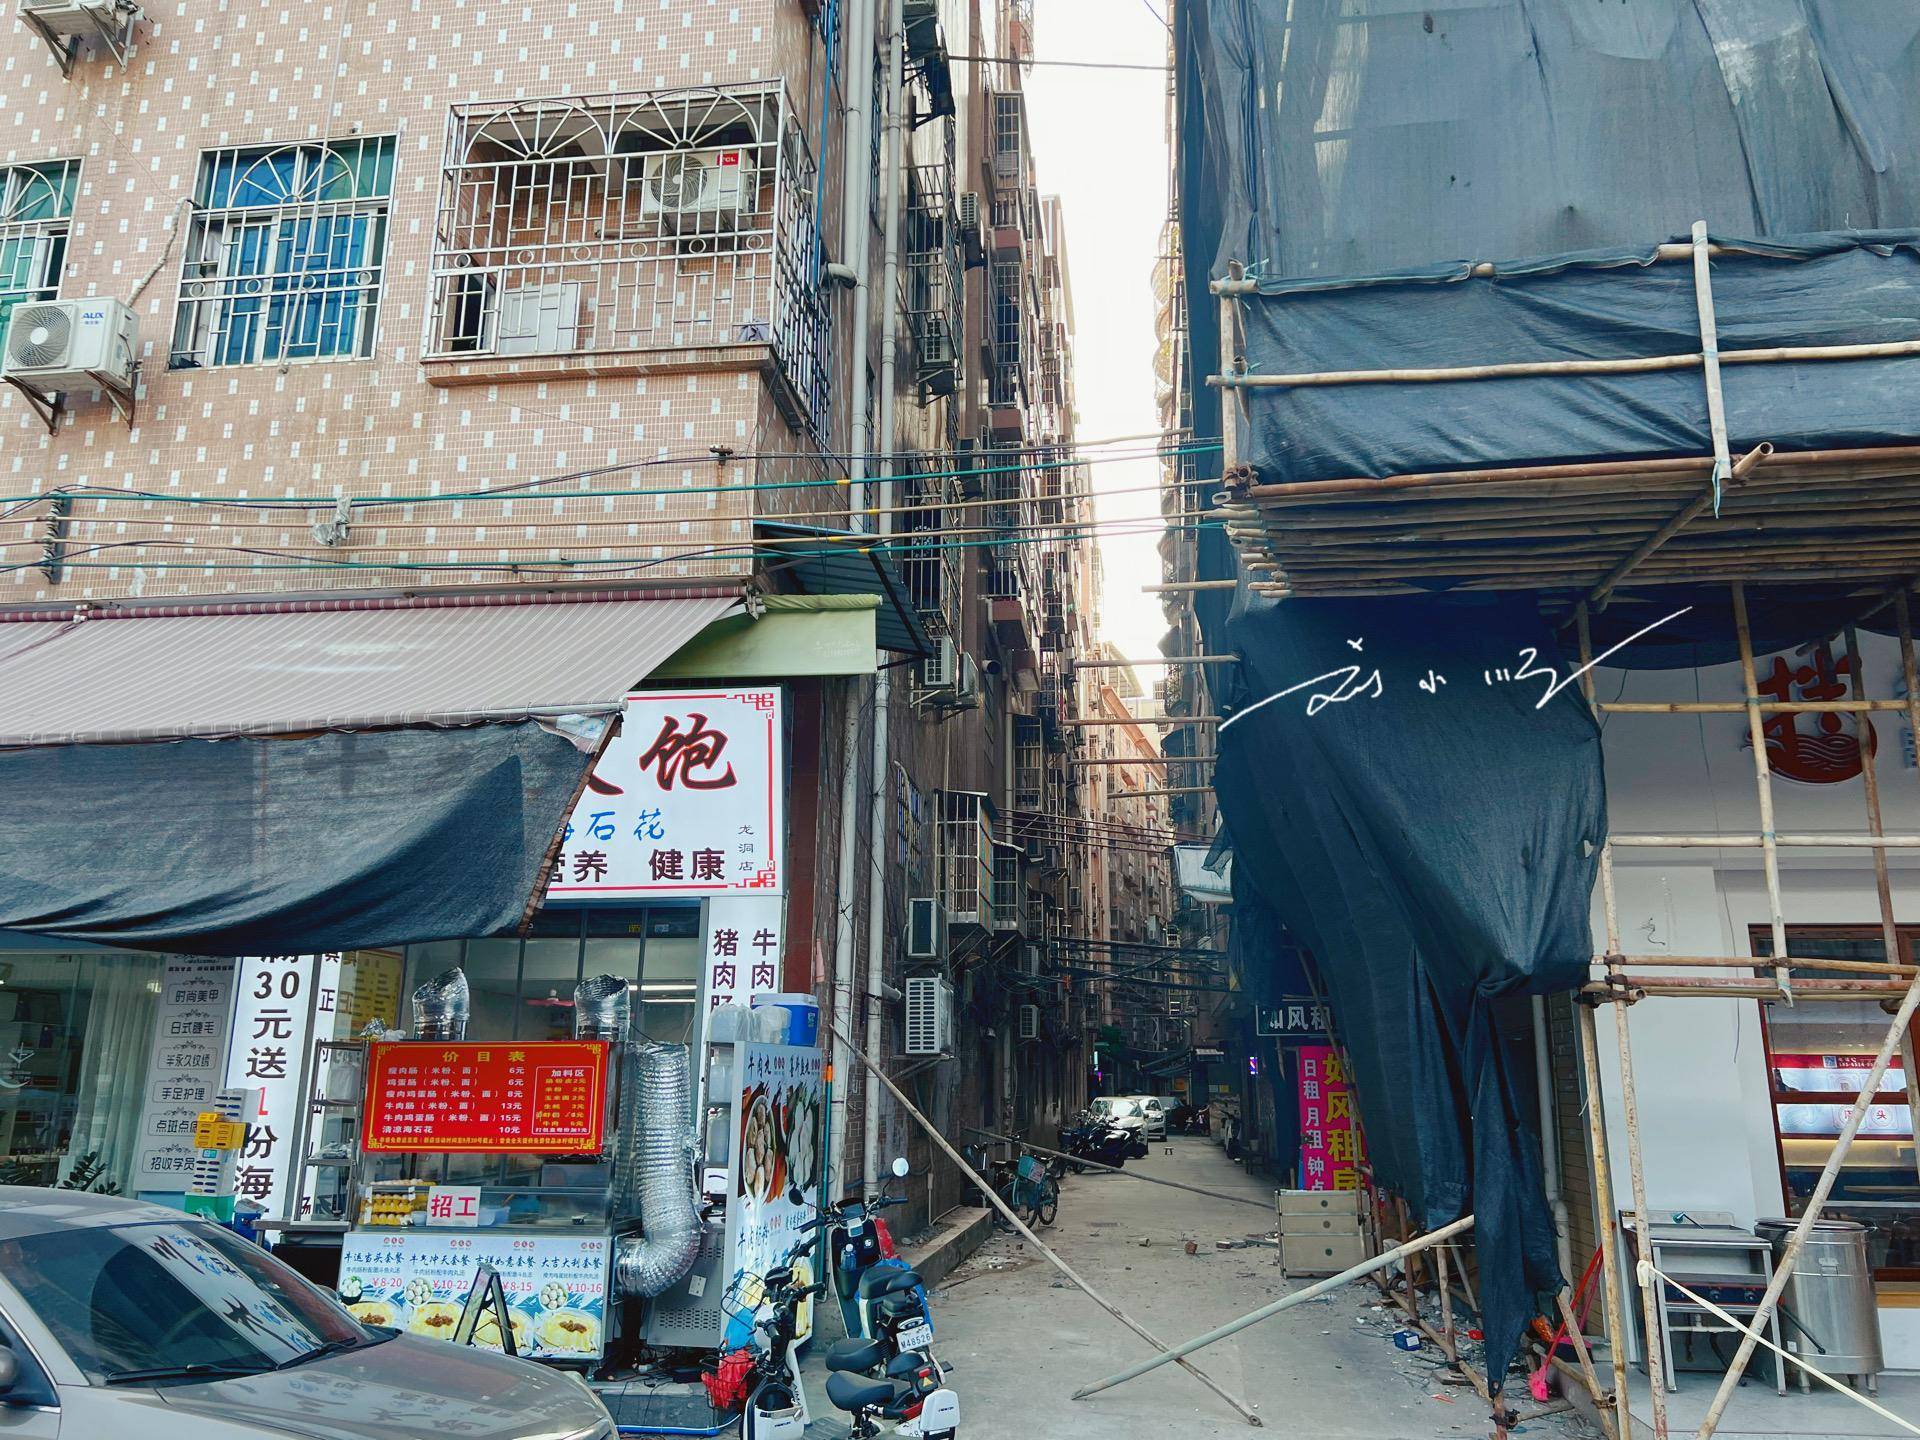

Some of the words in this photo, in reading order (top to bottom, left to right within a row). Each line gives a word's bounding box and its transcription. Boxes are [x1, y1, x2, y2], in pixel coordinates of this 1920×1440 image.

[587, 712, 738, 796] 饱
[738, 825, 754, 871] 龙洞店
[648, 847, 726, 881] 健康
[749, 928, 777, 1010] 牛肉
[175, 989, 219, 1002] 时尚美甲
[442, 1050, 526, 1062] 价目表
[509, 1066, 525, 1075] 6元
[551, 1069, 585, 1077] 加料区
[161, 1087, 205, 1101] 手足护理
[501, 1102, 523, 1110] 13元
[500, 1114, 522, 1122] 15元
[499, 1126, 521, 1134] 10元
[150, 1156, 195, 1171] 招收学员
[431, 1194, 477, 1218] 招工
